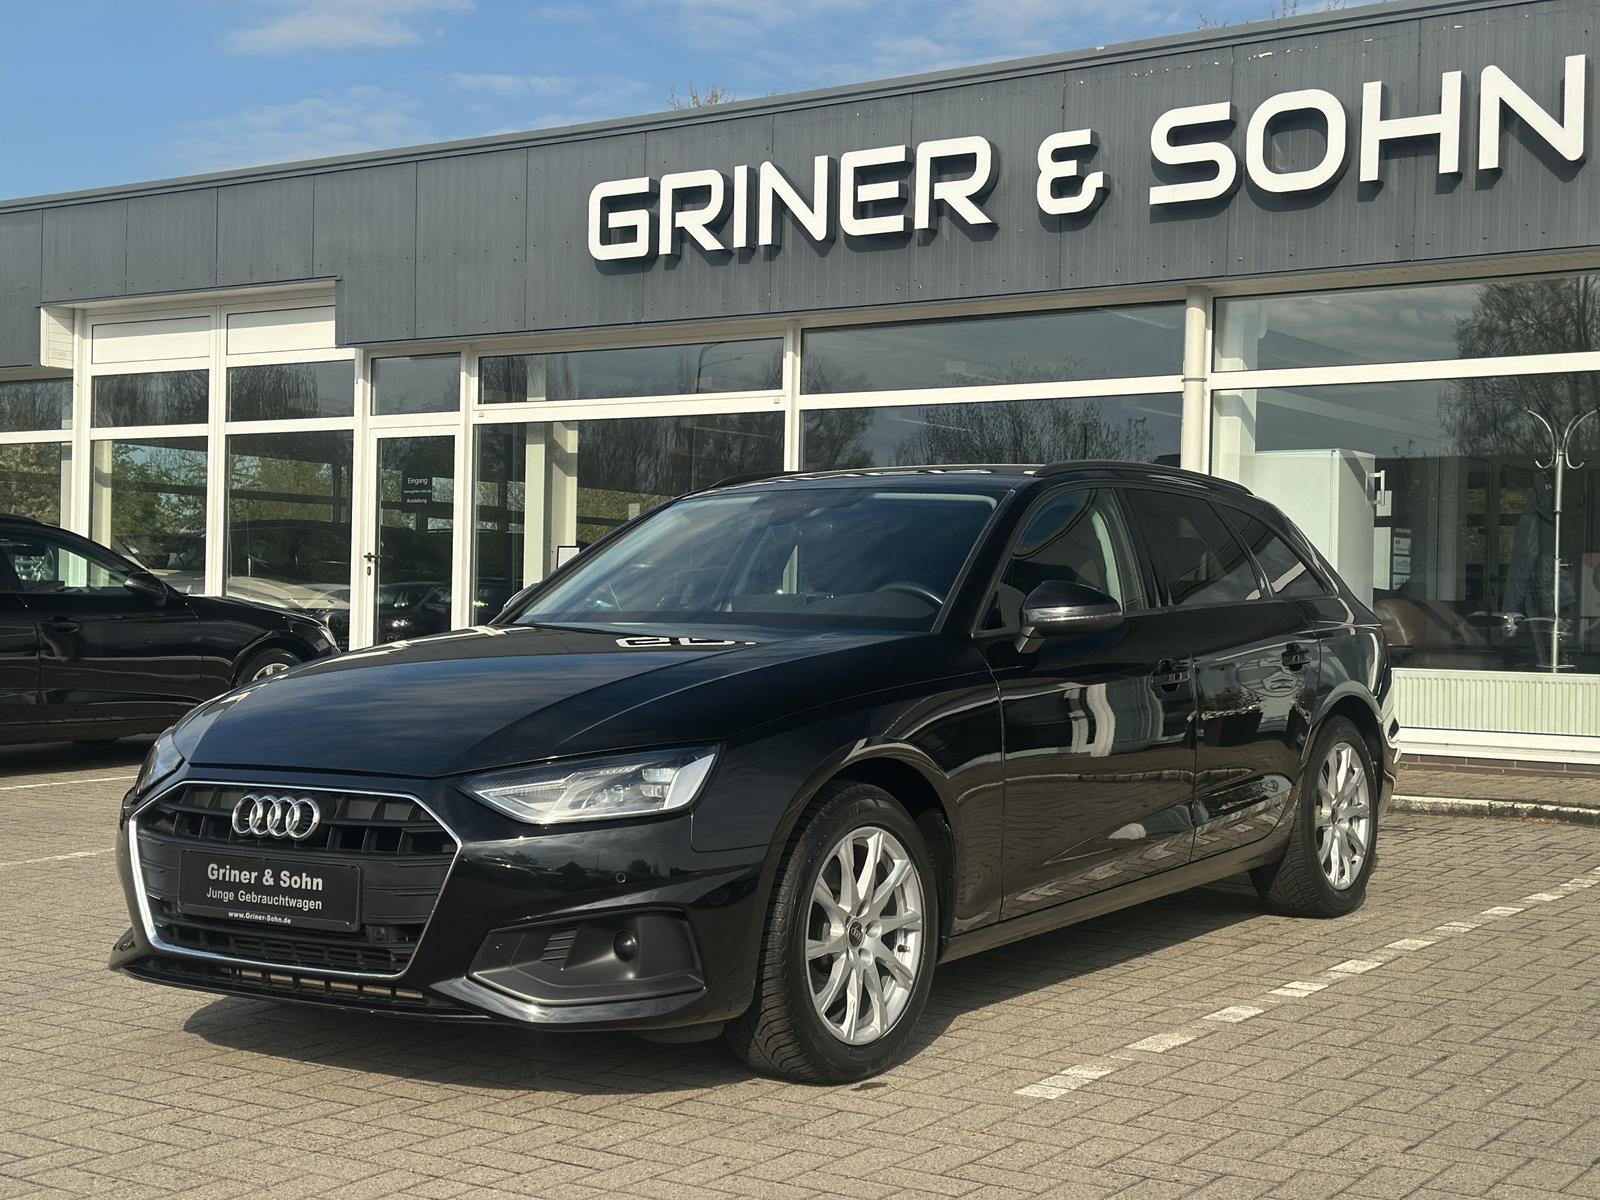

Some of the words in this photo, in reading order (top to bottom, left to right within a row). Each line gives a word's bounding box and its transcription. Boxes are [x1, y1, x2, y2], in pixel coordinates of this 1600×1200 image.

[588, 135, 992, 261] GRINER
[1037, 128, 1104, 215] &
[1149, 54, 1586, 205] SOHN
[407, 477, 428, 485] Eingang
[207, 863, 258, 884] Griner
[262, 869, 274, 886] &
[279, 870, 323, 891] Sohn
[206, 886, 235, 902] Junge
[238, 890, 322, 911] Gebrauchtwagen
[228, 911, 292, 924] www.Griner-Sohn.de
